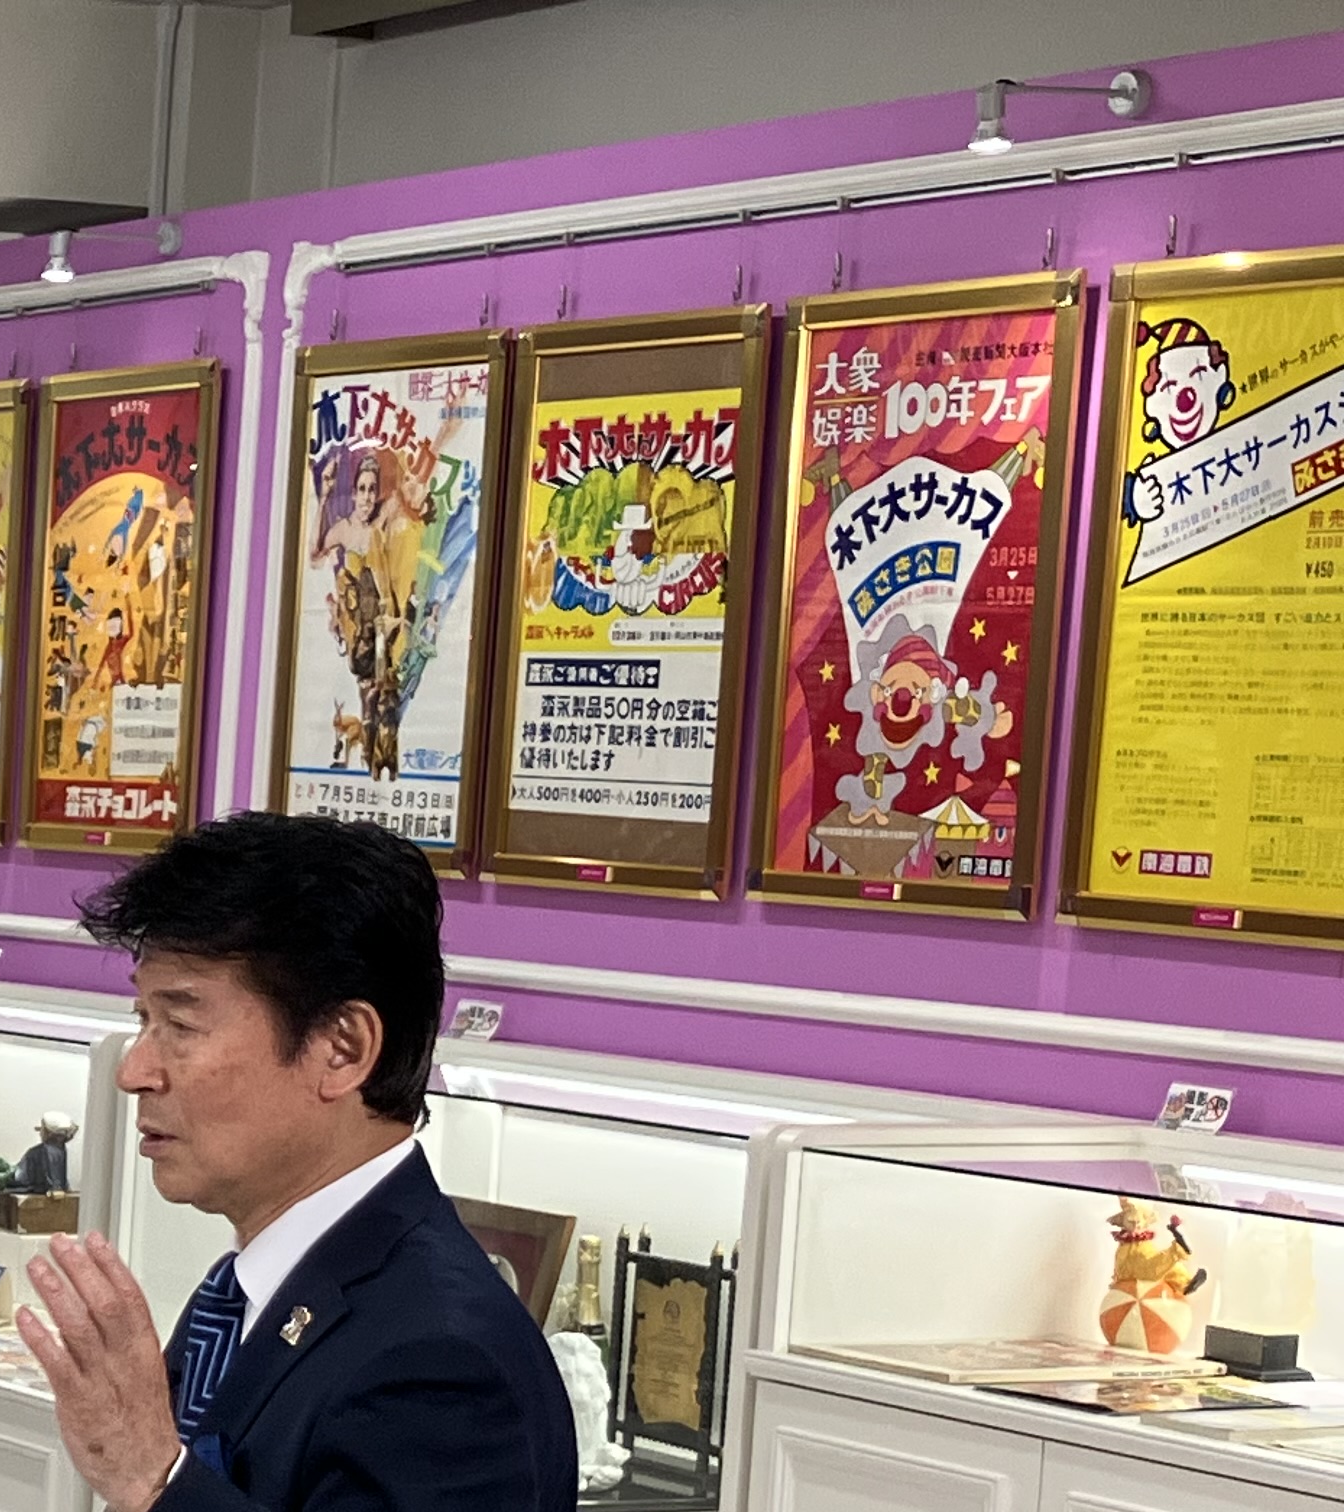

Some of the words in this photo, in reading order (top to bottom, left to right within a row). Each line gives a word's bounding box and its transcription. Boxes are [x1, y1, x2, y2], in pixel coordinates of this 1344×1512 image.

[814, 346, 882, 396] 大衆
[812, 403, 878, 448] 娯楽
[830, 471, 1004, 571] 木下大サーカス
